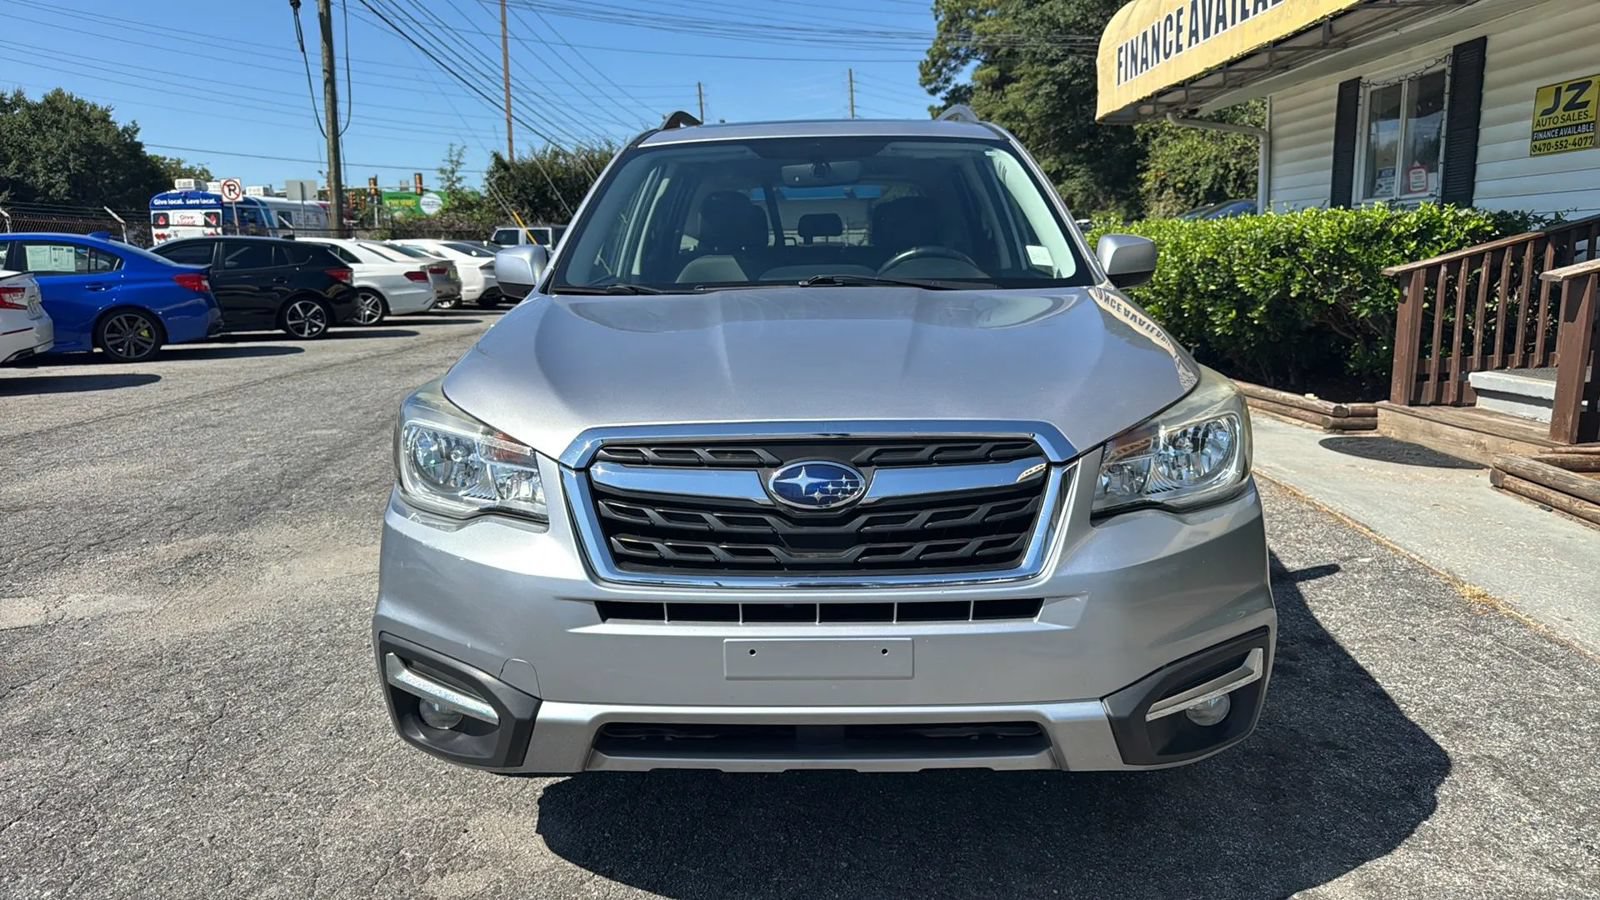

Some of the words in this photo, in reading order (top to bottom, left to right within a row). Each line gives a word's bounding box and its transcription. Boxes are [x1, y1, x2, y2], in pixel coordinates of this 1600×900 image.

[1117, 7, 1184, 86] FINANCE
[1188, 0, 1283, 48] AVAI
[1540, 80, 1592, 117] JZ
[1535, 116, 1559, 128] AUTO
[1560, 110, 1589, 124] SALES
[1533, 130, 1559, 141] FINANCE
[1560, 122, 1594, 137] AVAILABLE
[1536, 135, 1594, 153] 470-552-4077
